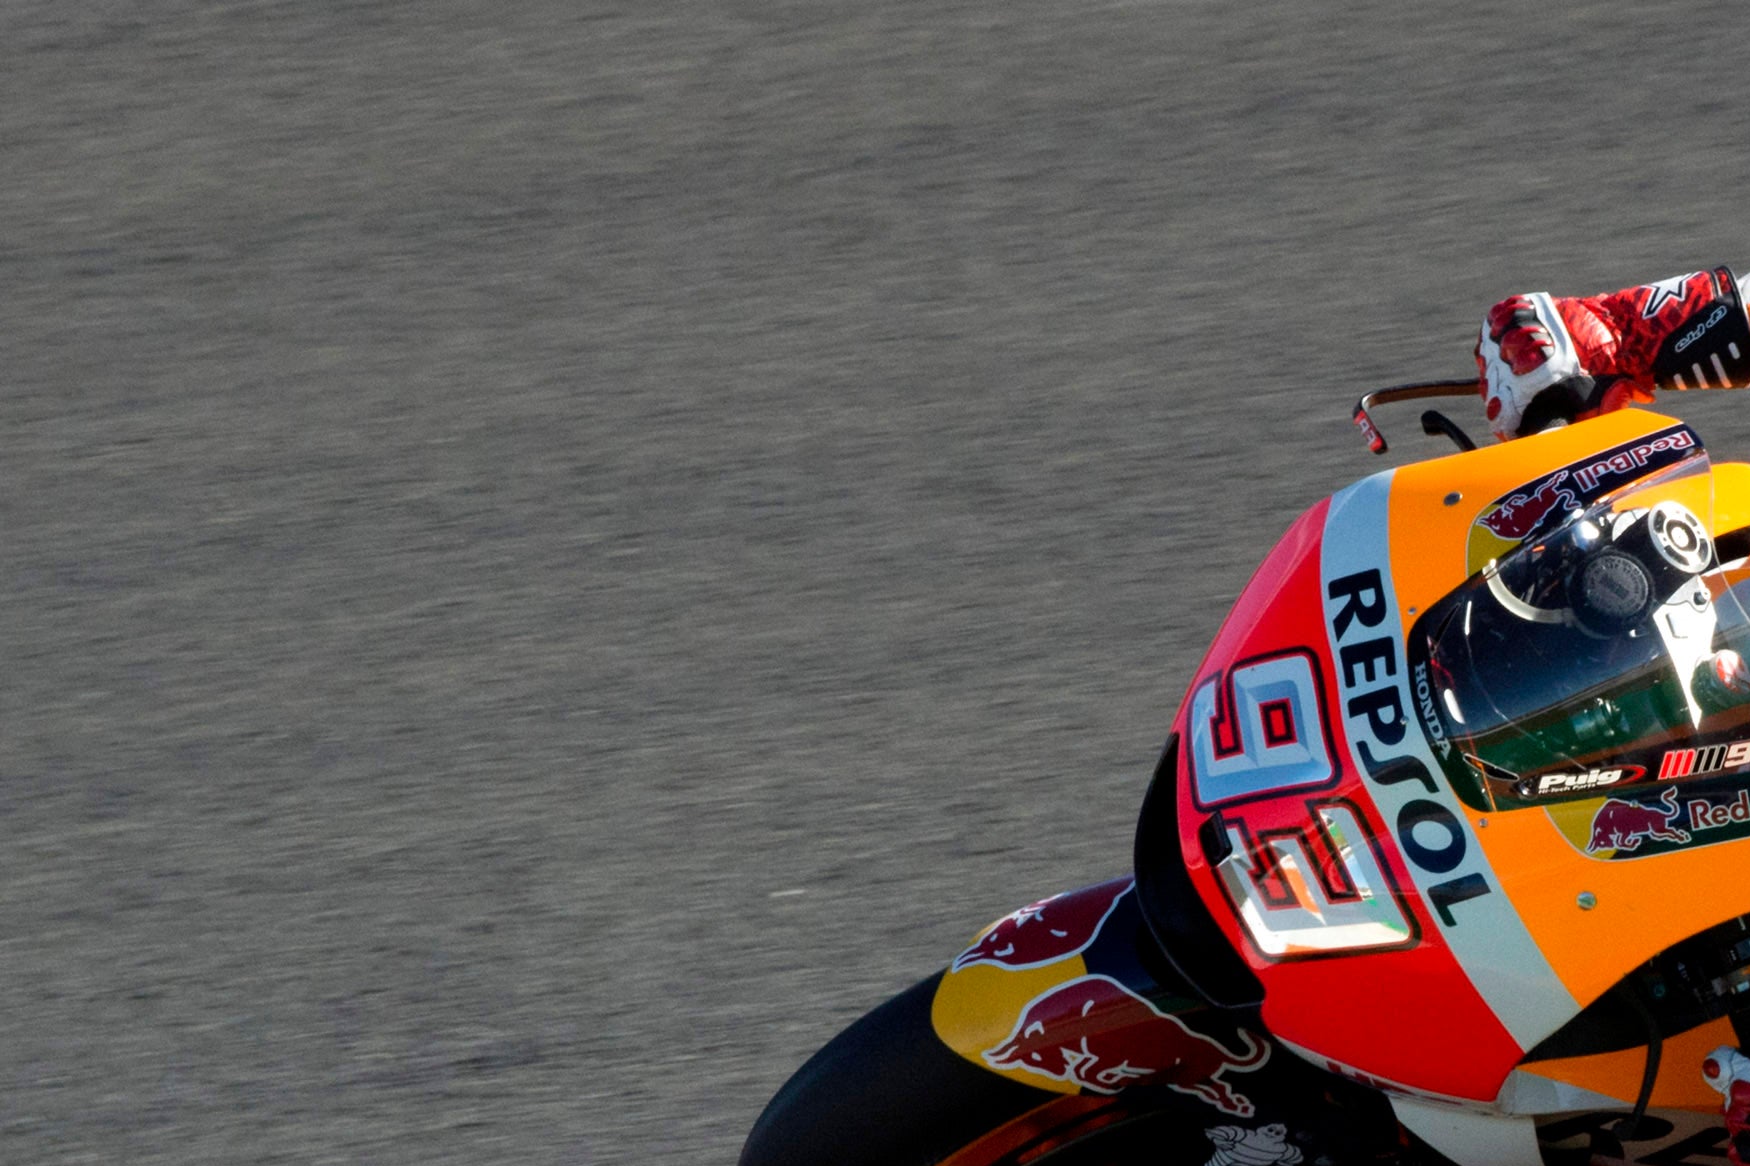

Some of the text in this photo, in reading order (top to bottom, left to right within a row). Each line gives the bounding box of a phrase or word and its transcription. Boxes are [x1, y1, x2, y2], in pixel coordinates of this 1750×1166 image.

[1573, 430, 1696, 492] Red Bull
[1328, 568, 1492, 928] REPSOL
[1415, 661, 1454, 762] HONDA
[1186, 646, 1422, 964] 93
[1539, 769, 1623, 790] Puig
